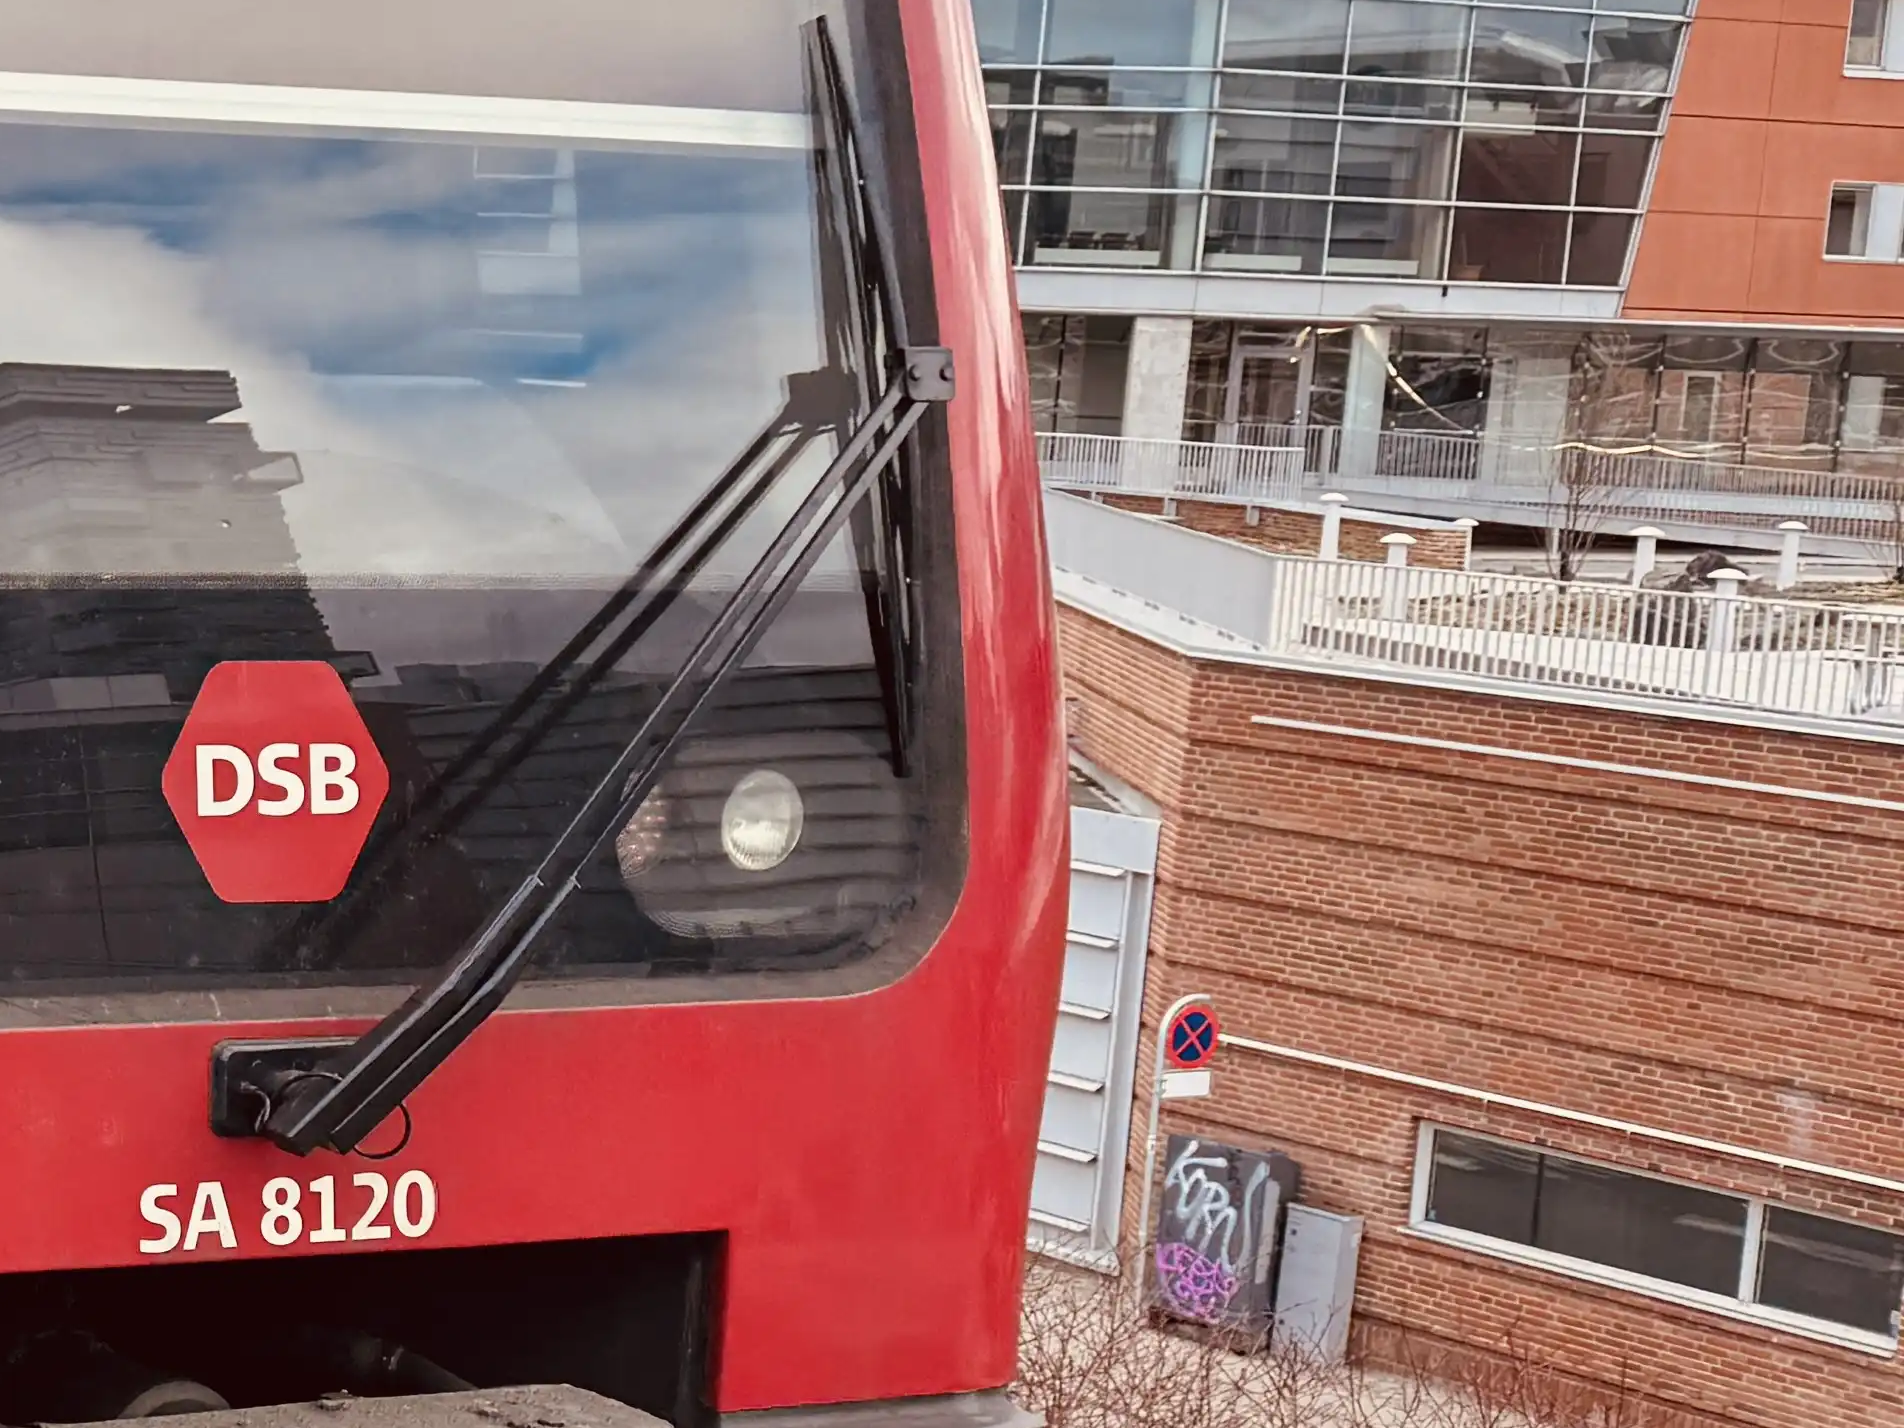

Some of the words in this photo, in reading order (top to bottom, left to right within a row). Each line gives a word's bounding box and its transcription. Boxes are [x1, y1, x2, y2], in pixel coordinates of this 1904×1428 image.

[196, 742, 360, 817] DSB
[139, 1181, 237, 1254] SA
[260, 1169, 437, 1247] 8120
